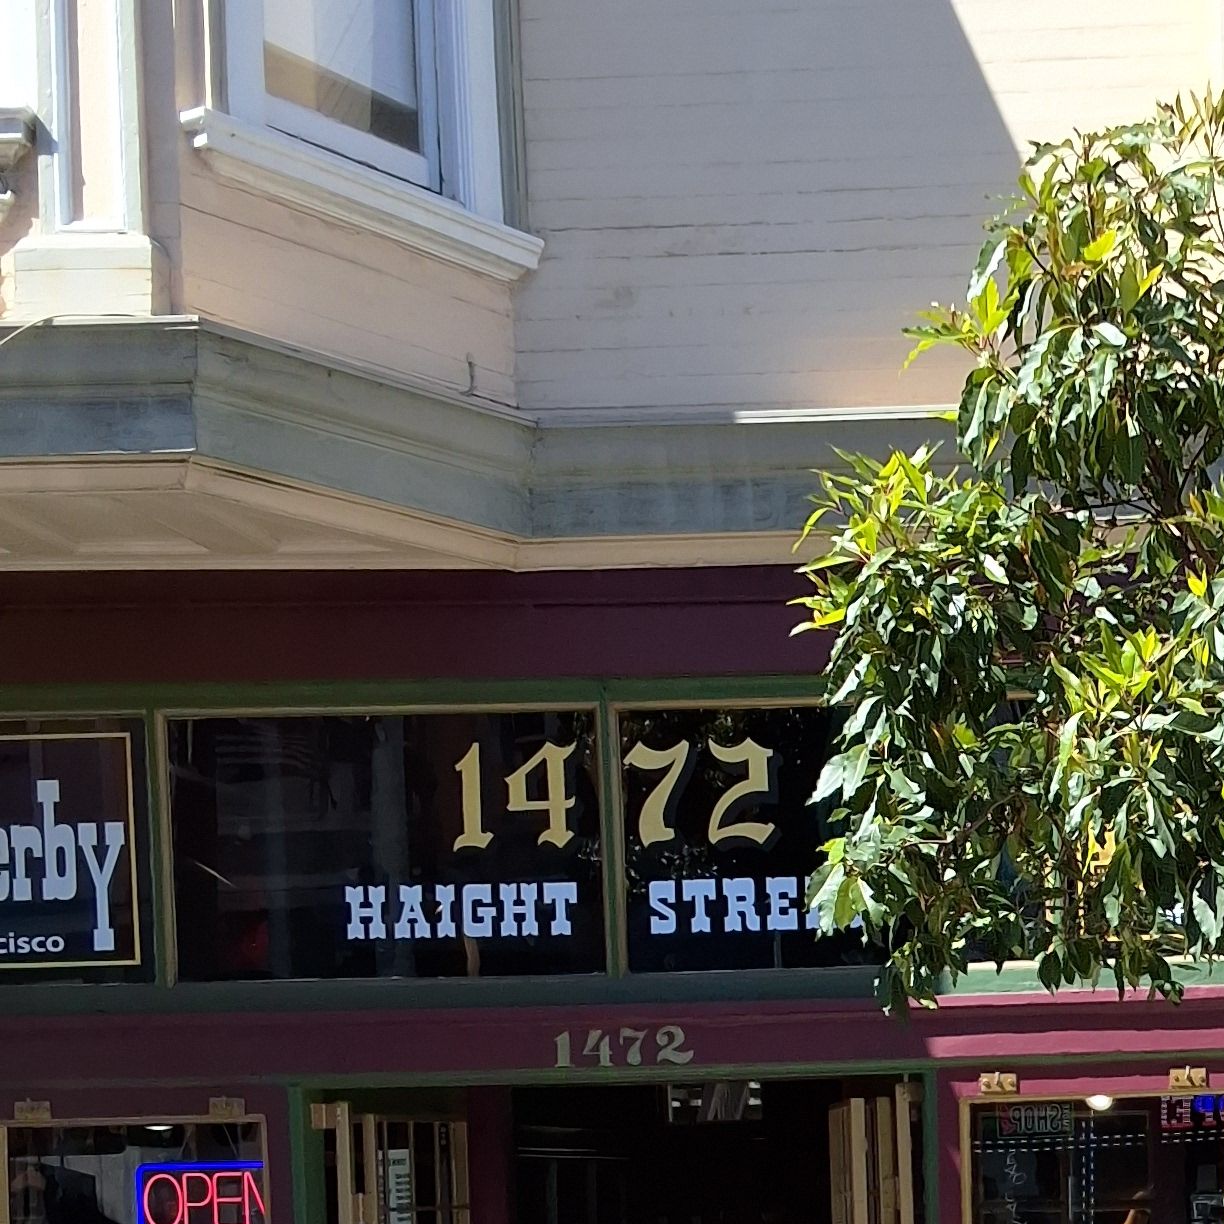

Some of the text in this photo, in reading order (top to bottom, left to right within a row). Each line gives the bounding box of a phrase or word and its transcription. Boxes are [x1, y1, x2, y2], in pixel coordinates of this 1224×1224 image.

[453, 737, 776, 853] 1472
[345, 876, 866, 940] HAIGHT STRE
[554, 1025, 694, 1068] 1472
